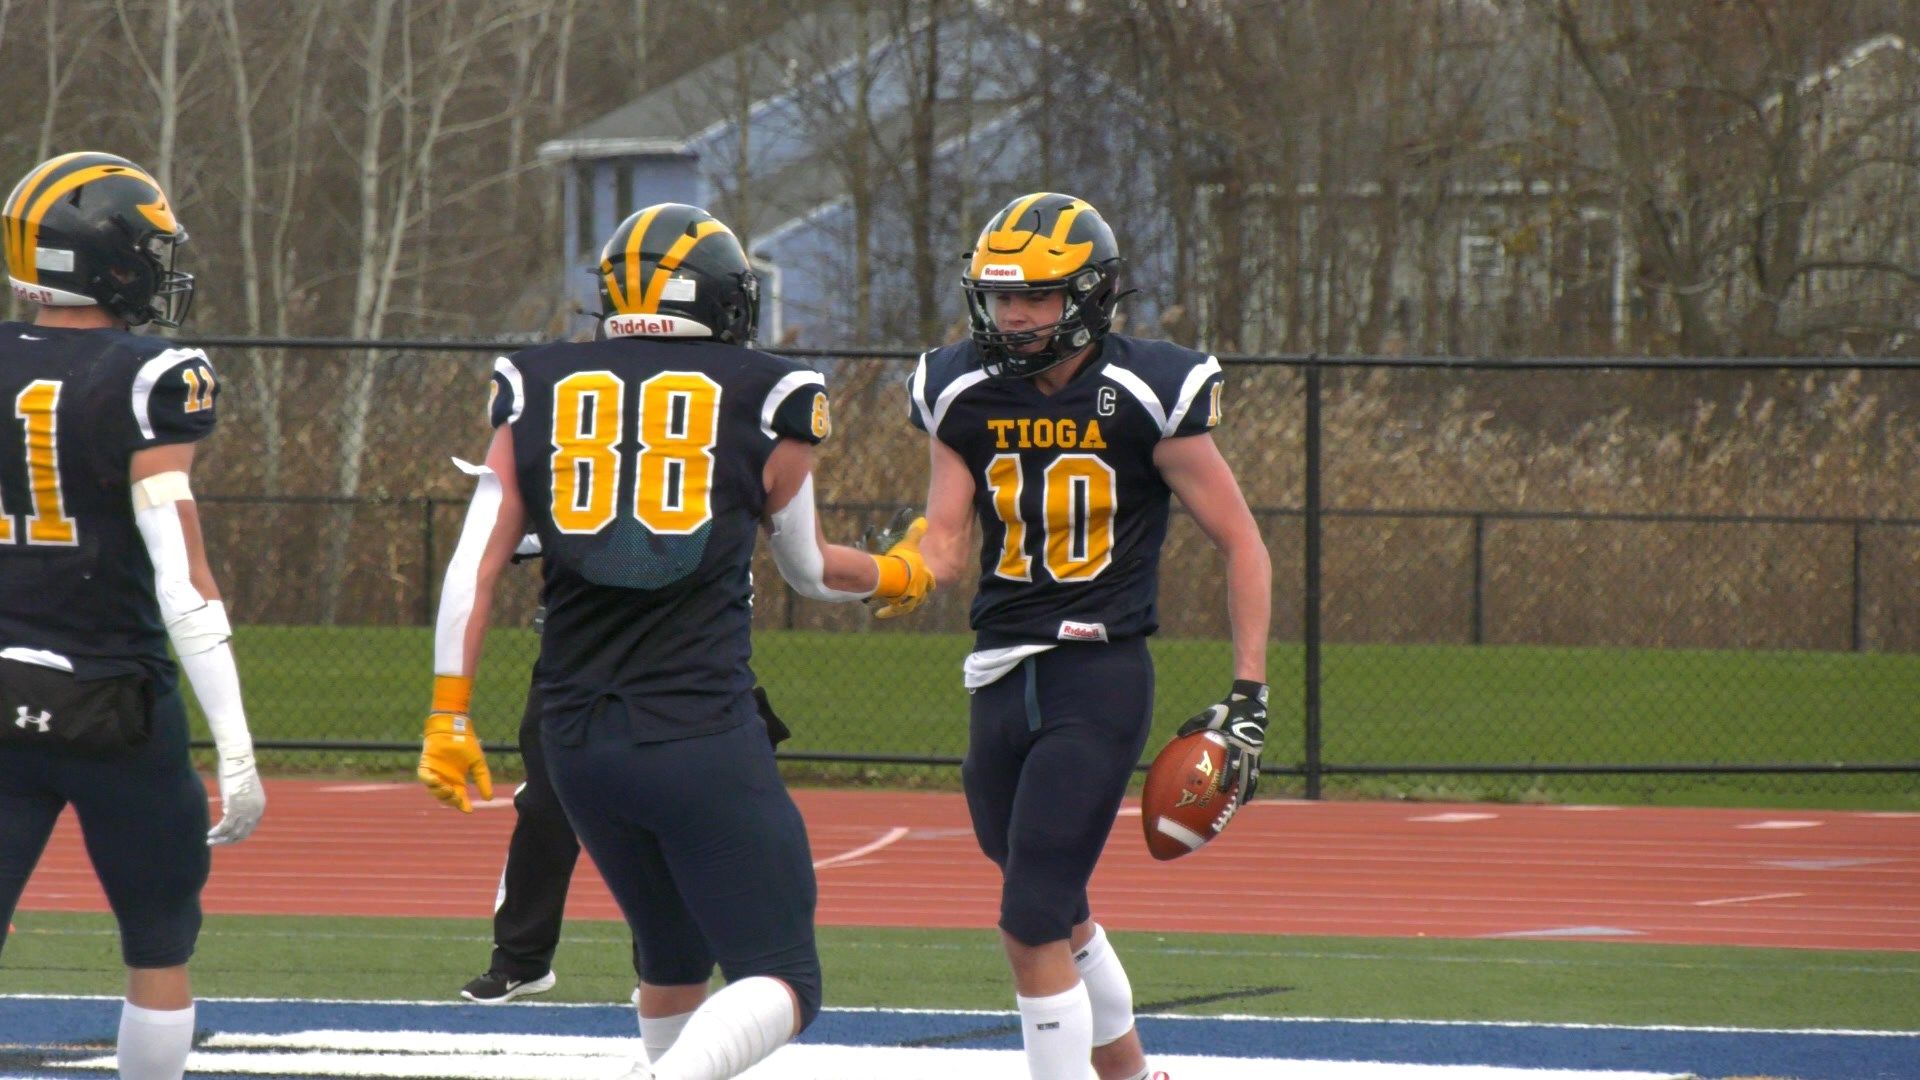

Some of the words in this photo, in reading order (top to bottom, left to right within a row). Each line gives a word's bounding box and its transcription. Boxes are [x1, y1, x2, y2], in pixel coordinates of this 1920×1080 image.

[985, 267, 1017, 276] Riddell
[610, 319, 674, 335] Riddell
[182, 366, 215, 413] 11
[1097, 387, 1116, 416] C
[1206, 380, 1225, 426] 1
[811, 391, 831, 438] 8
[987, 418, 1107, 449] TIOGA
[0, 379, 79, 546] 1
[550, 370, 722, 534] 88
[984, 453, 1118, 583] 10
[1064, 625, 1100, 637] Riddell
